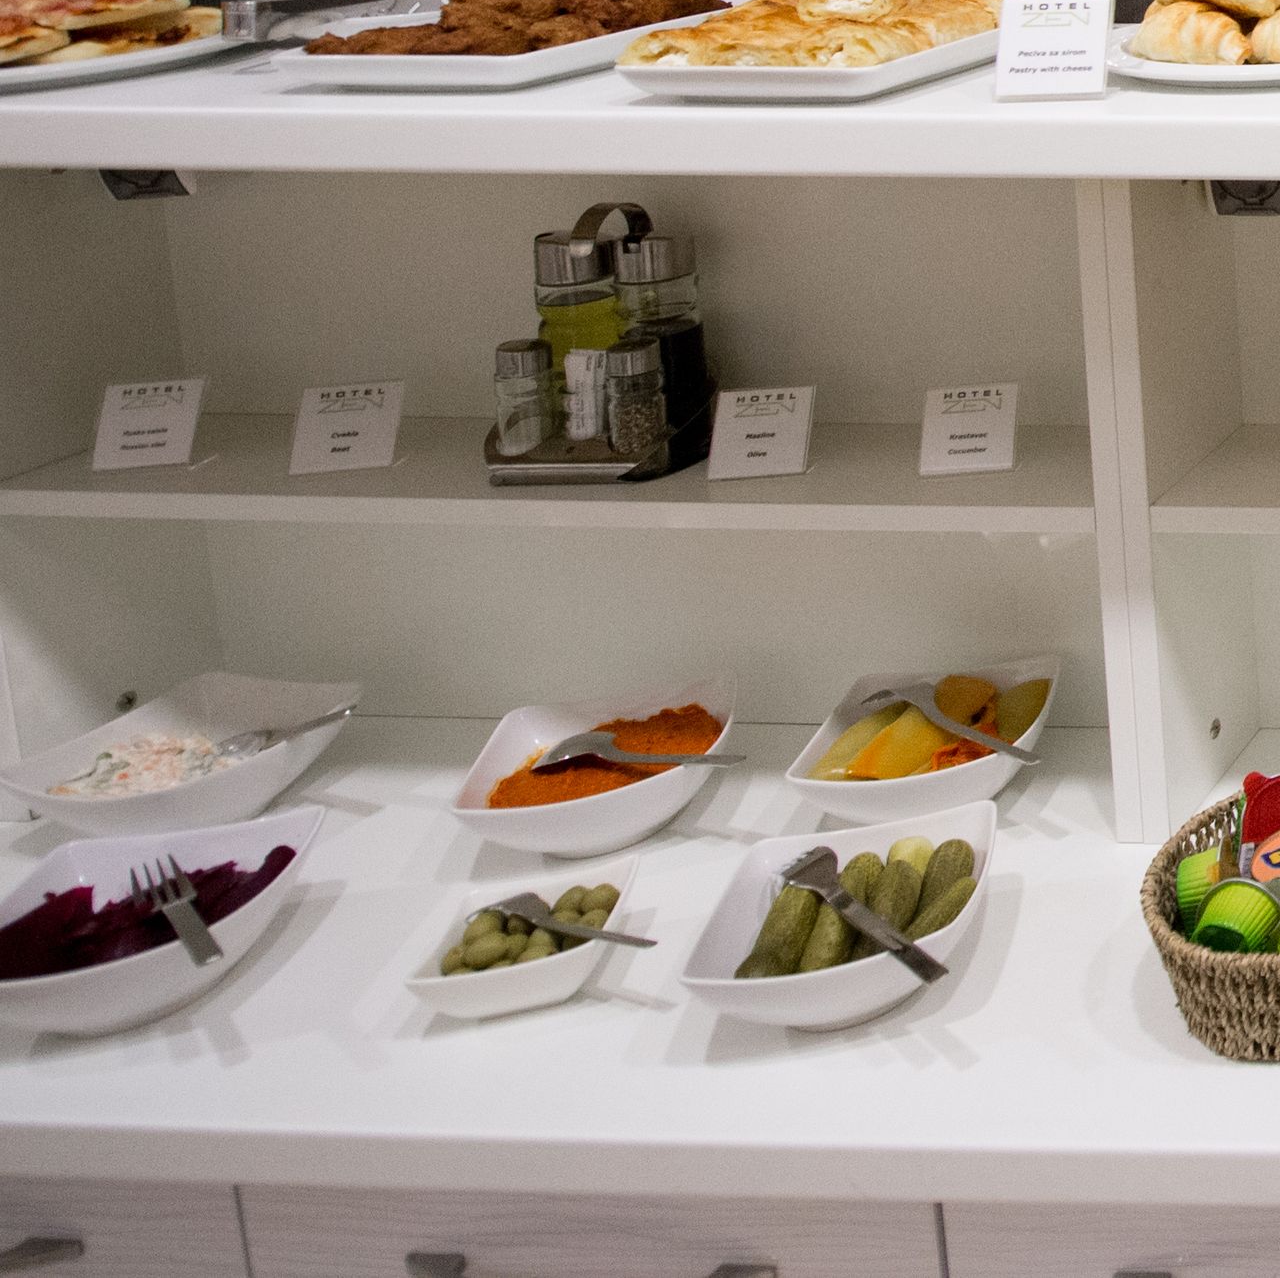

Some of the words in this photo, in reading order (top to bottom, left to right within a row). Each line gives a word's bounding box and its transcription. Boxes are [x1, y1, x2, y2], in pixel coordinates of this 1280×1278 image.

[1023, 2, 1091, 11] HOTEL
[1021, 11, 1090, 28] ZEN
[123, 386, 184, 396] HOTEL
[321, 388, 385, 400] HOTEL
[943, 389, 1003, 400] HOTEL
[736, 393, 796, 403] HOTEL
[948, 447, 987, 456] Cucumber
